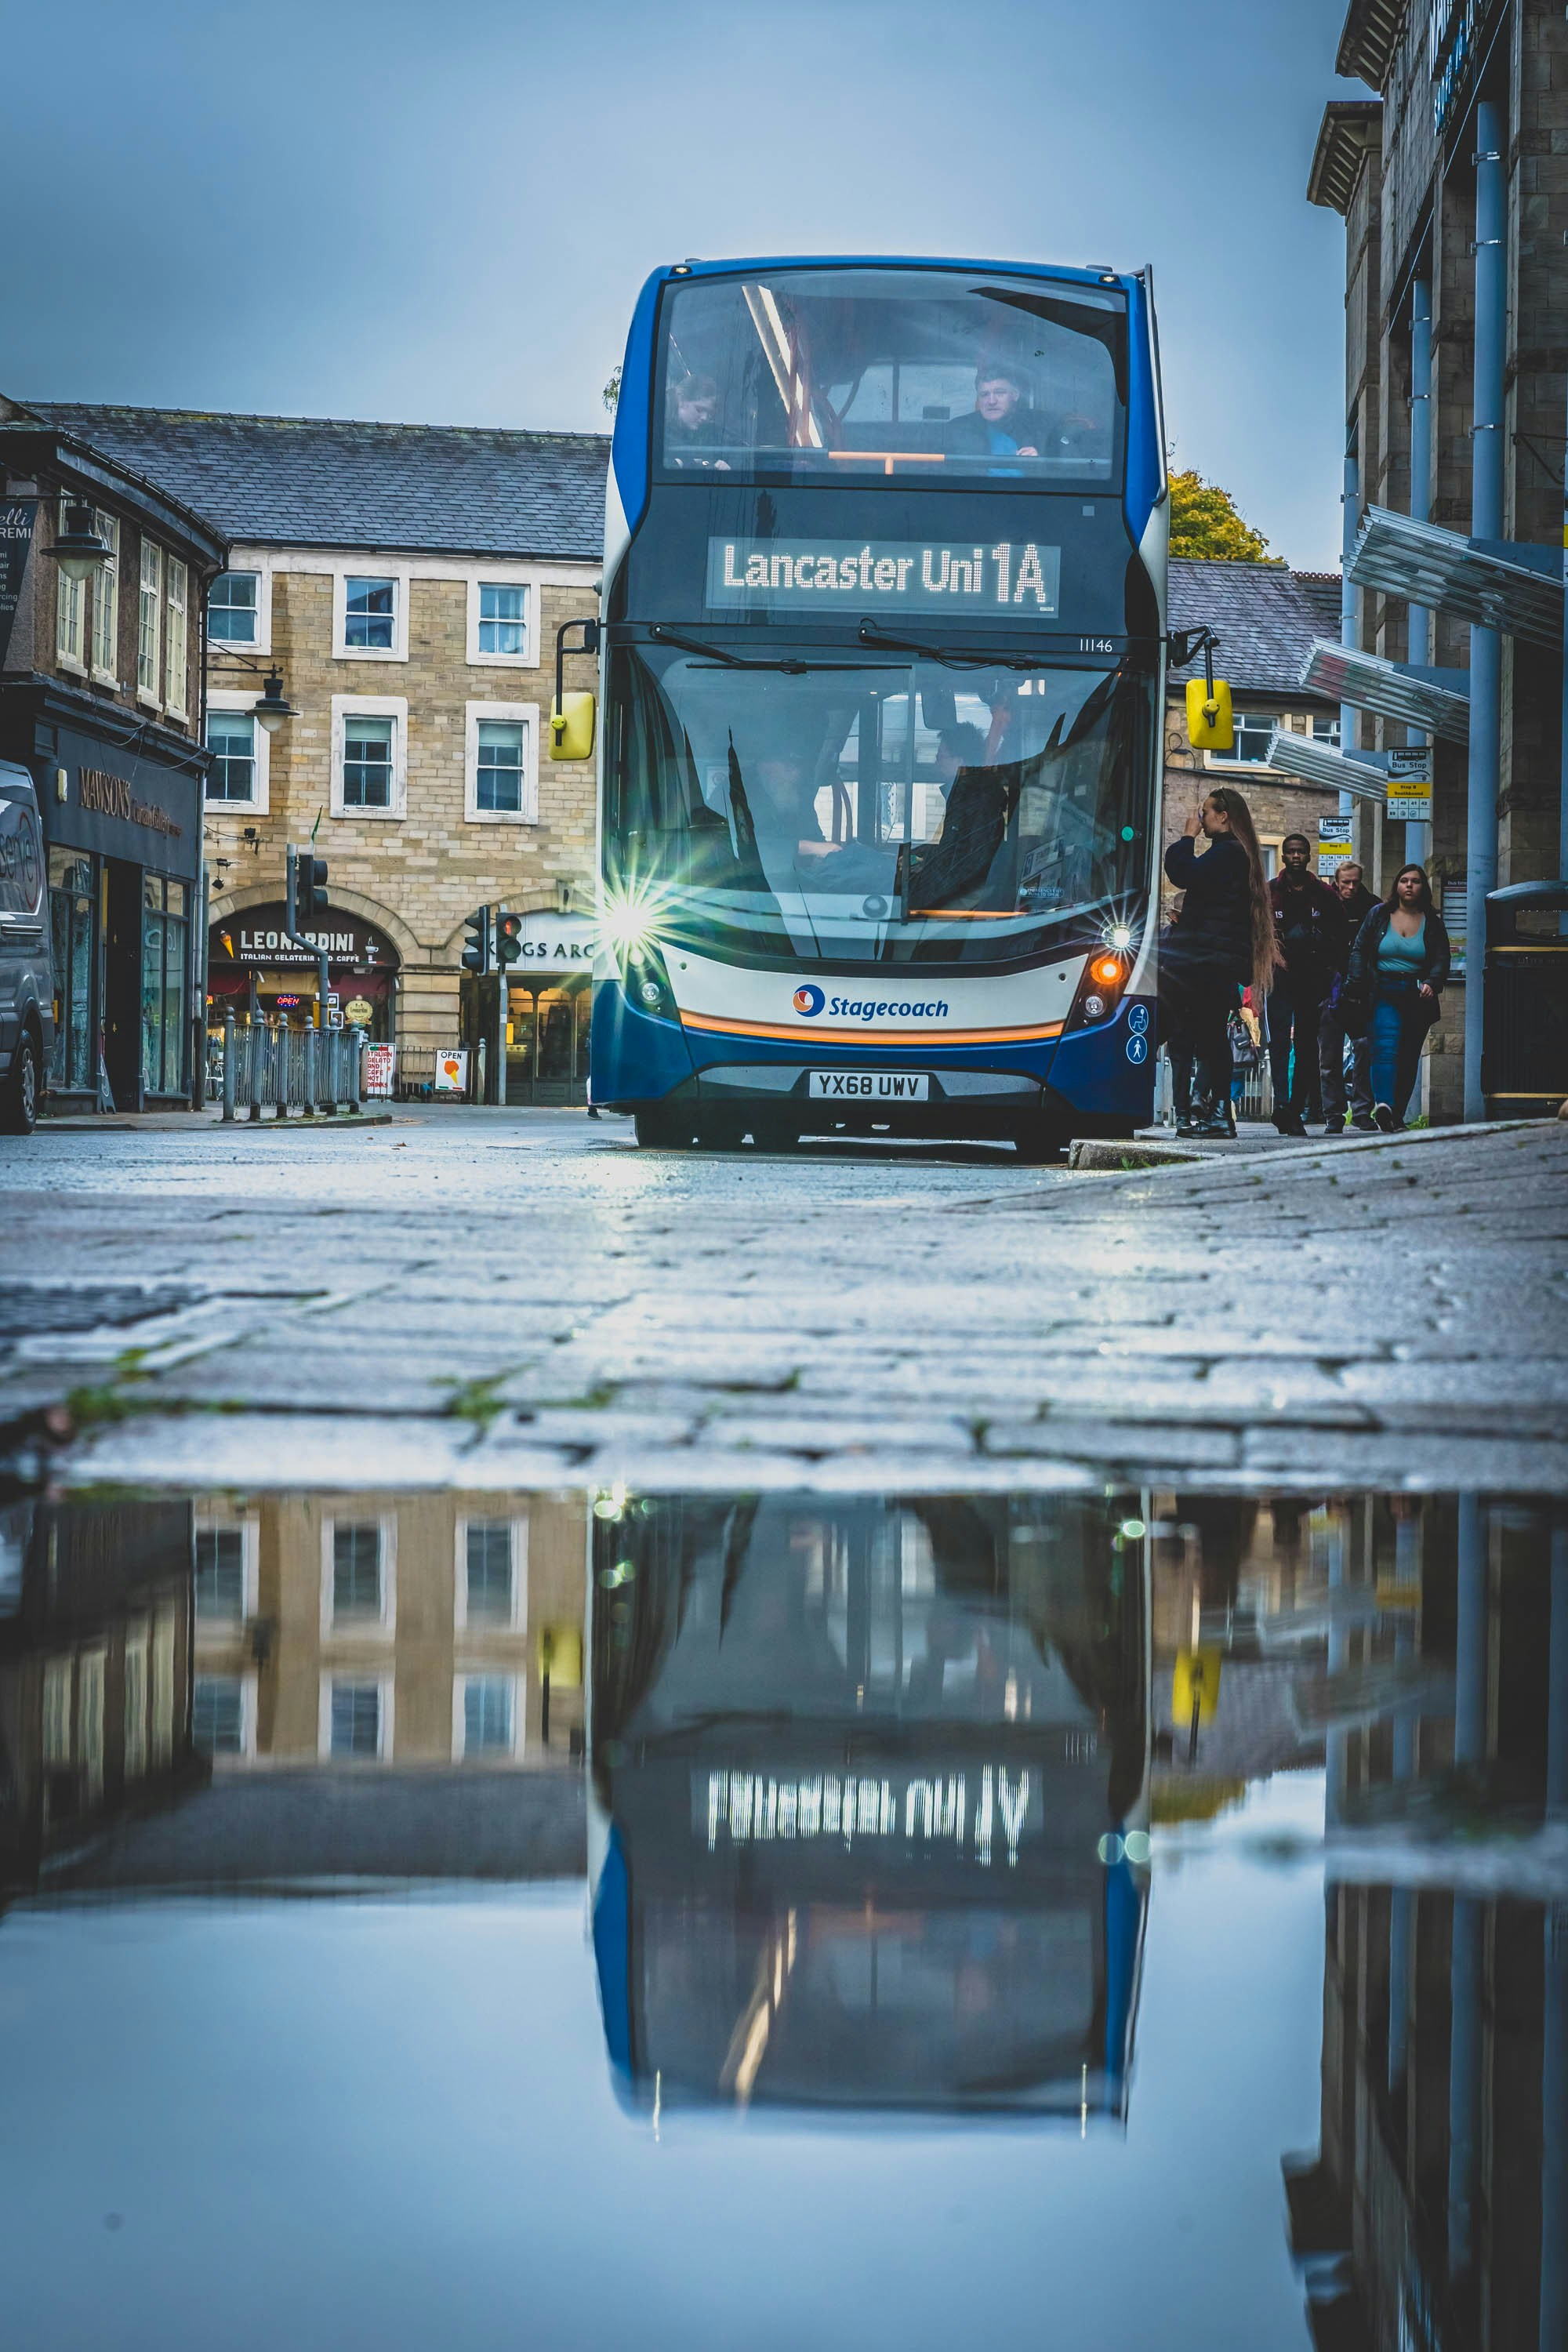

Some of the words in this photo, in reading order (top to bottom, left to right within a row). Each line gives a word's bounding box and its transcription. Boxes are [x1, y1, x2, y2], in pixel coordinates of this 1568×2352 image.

[724, 544, 913, 590] Lancaster
[923, 548, 982, 592] Uni
[993, 543, 1047, 603] 1A
[1080, 638, 1112, 652] 11146
[829, 997, 949, 1022] Stagecoach
[819, 1075, 873, 1094] YX68
[879, 1076, 919, 1097] UWV
